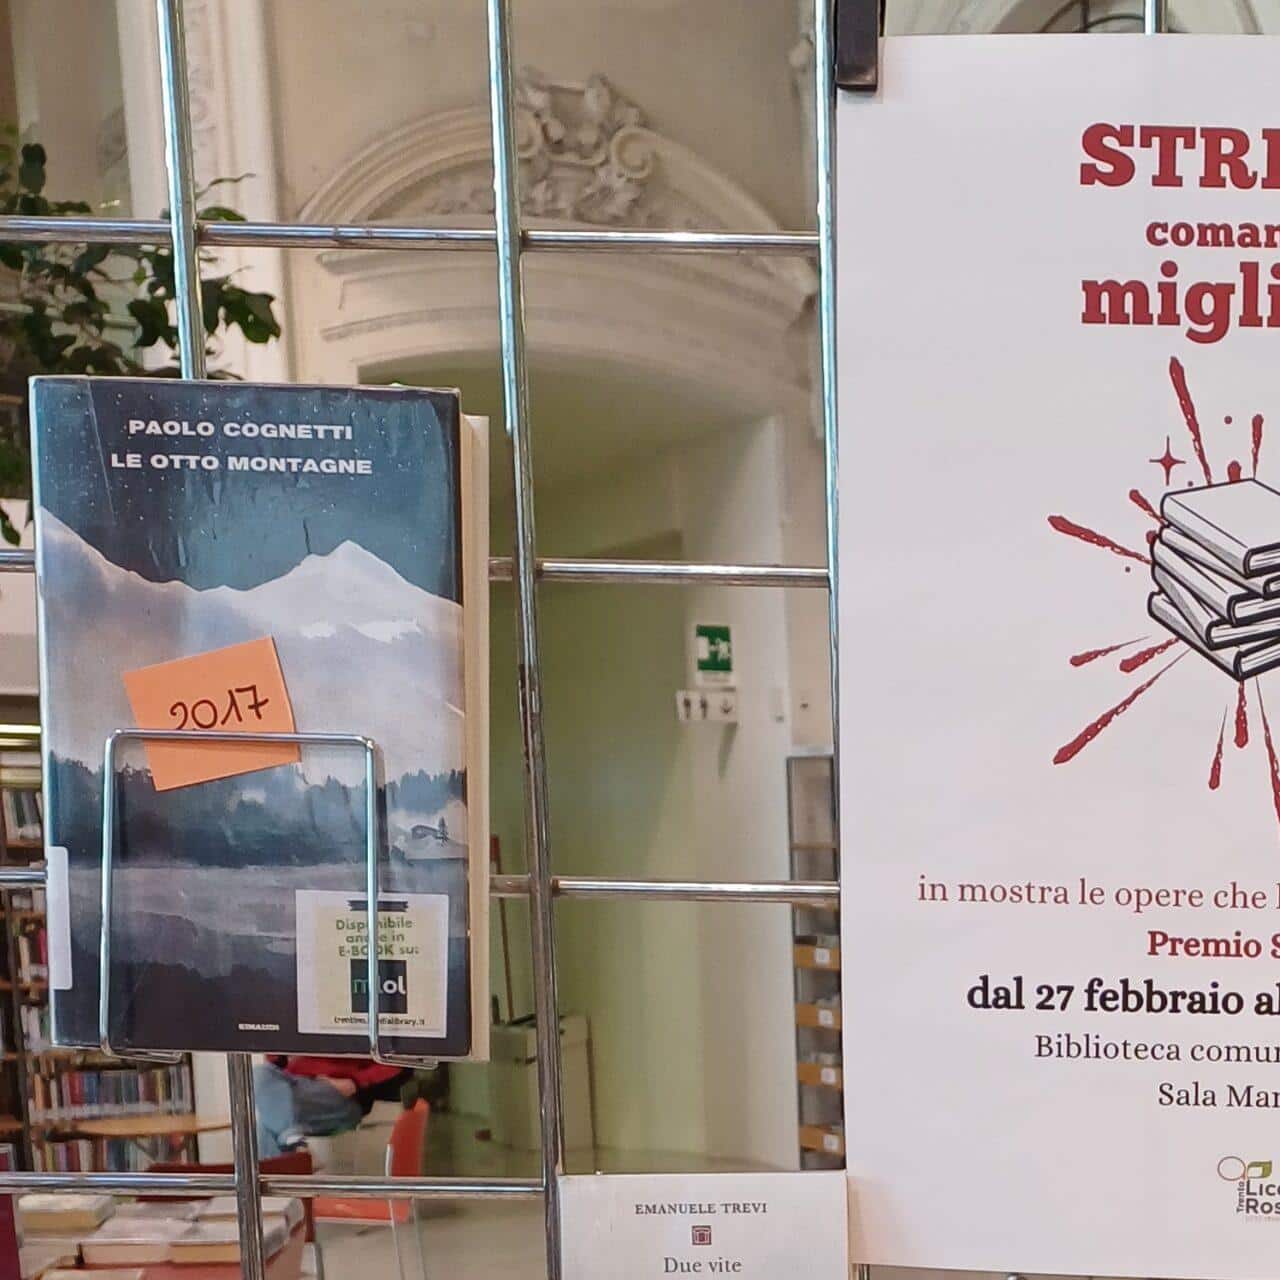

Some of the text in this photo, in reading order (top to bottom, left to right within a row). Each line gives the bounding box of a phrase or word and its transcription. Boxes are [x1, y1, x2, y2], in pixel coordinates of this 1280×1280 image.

[128, 419, 354, 442] PAOLO COGNETTI
[111, 453, 374, 476] LE OTTO MONTAGNE
[170, 684, 270, 732] 2017
[917, 874, 948, 902] in
[958, 879, 1070, 905] mostra
[1078, 878, 1105, 905] le
[1114, 886, 1204, 914] opere
[1213, 881, 1267, 909] che
[1147, 930, 1262, 958] Premio
[967, 974, 1025, 1010] dal
[1035, 985, 1075, 1011] 27
[1084, 977, 1244, 1015] febbraio
[1035, 1033, 1181, 1061] Biblioteca
[1158, 1081, 1217, 1107] Sala
[635, 1202, 768, 1215] EMANUELE TREVI
[1236, 1181, 1245, 1213] Trento
[664, 1256, 742, 1273] Due vite
